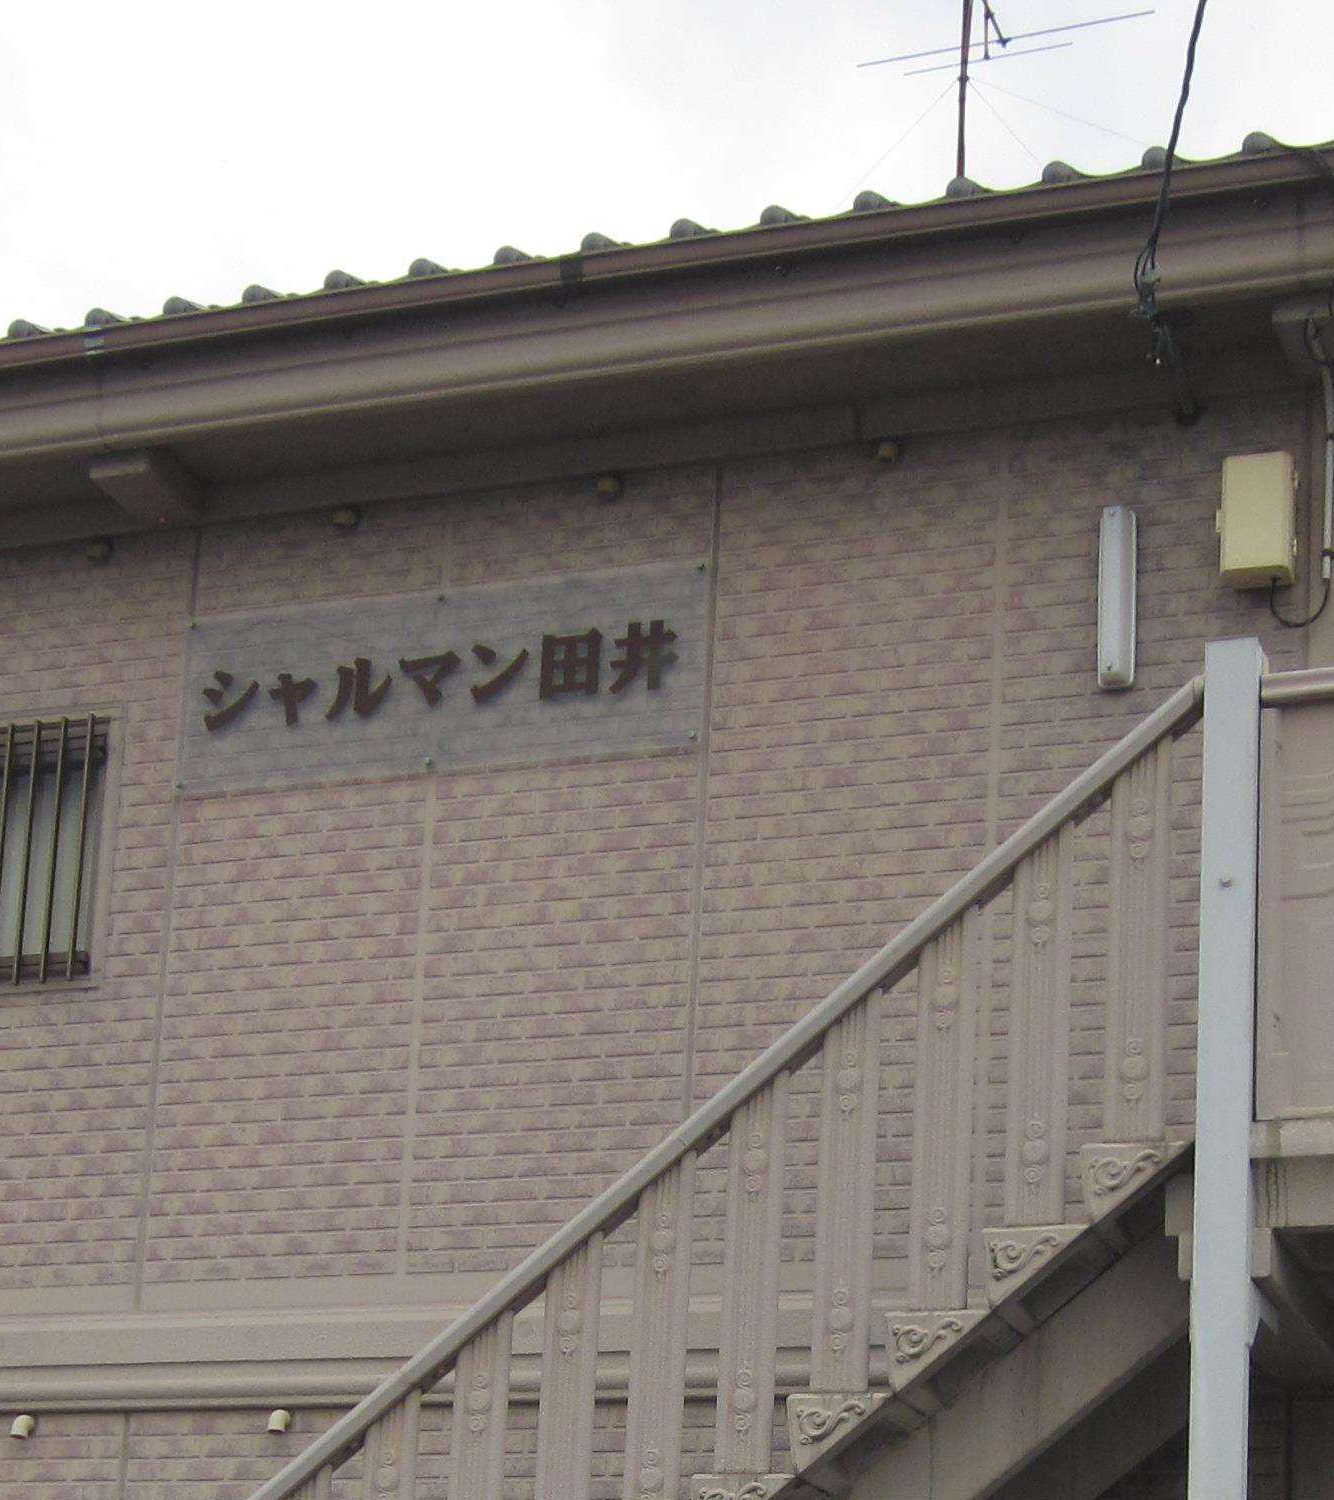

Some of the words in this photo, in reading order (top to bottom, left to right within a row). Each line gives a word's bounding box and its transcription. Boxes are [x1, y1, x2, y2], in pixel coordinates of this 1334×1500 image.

[203, 619, 678, 732] シャルマン田井
